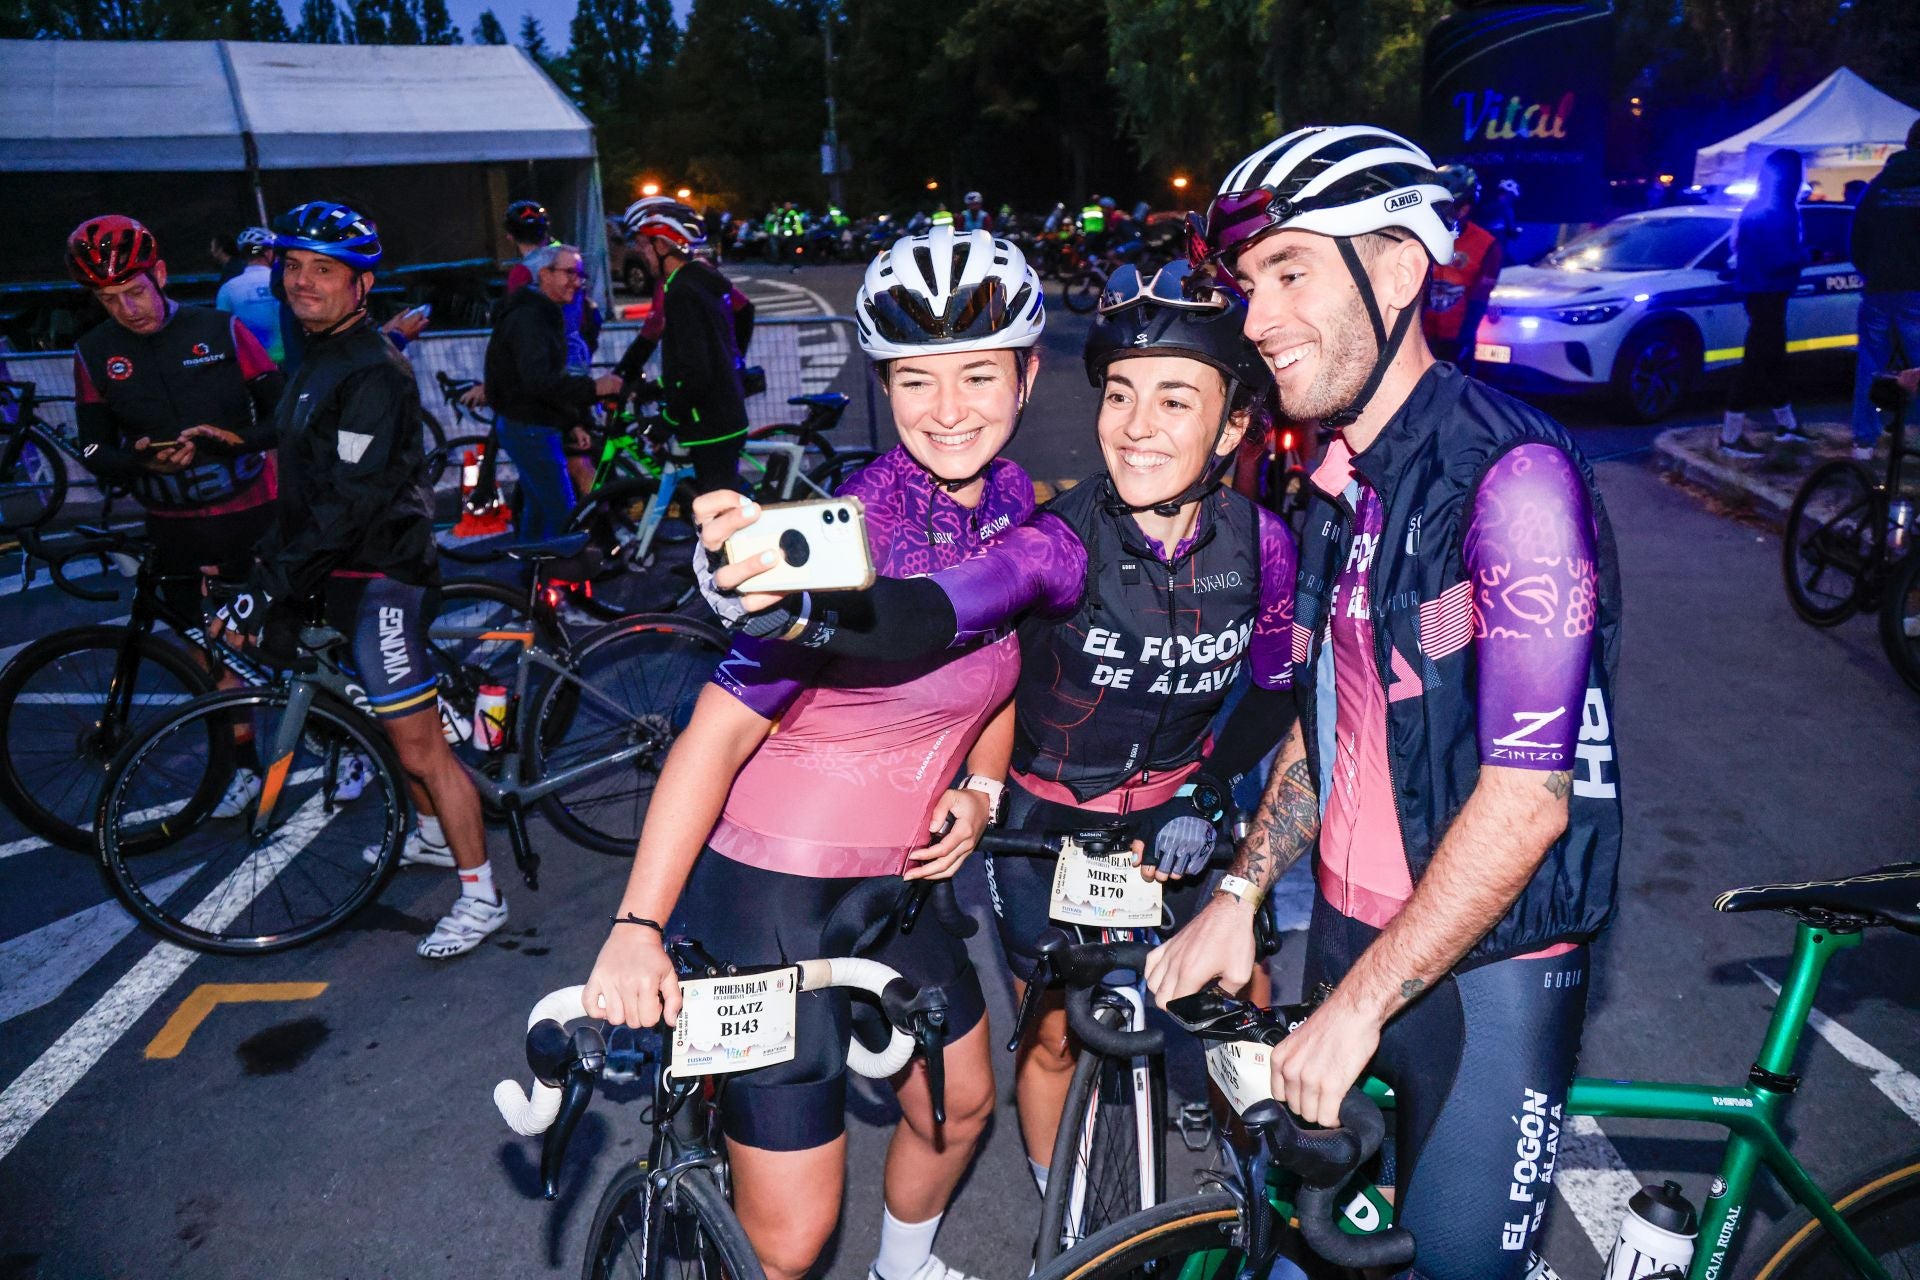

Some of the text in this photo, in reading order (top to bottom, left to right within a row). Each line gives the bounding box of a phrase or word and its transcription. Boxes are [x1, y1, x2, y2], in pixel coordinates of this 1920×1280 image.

[1453, 89, 1575, 142] Vital
[1390, 193, 1419, 209] ABUS
[379, 606, 412, 685] VIKINGS
[1082, 617, 1255, 668] EL FOGÓN
[1091, 664, 1134, 689] DE
[1490, 749, 1563, 761] ZINTZO
[1087, 869, 1128, 883] MIREN
[1089, 884, 1124, 899] B170
[745, 979, 768, 995] BLAN
[717, 1001, 763, 1017] OLATZ
[720, 1019, 759, 1037] B143
[722, 1045, 753, 1059] Vital
[1538, 1103, 1562, 1184] ÁLAVA
[1502, 1087, 1548, 1250] EL FOGÓN
[1530, 1199, 1547, 1233] DE
[1705, 1205, 1742, 1280] CAJA RURAL
